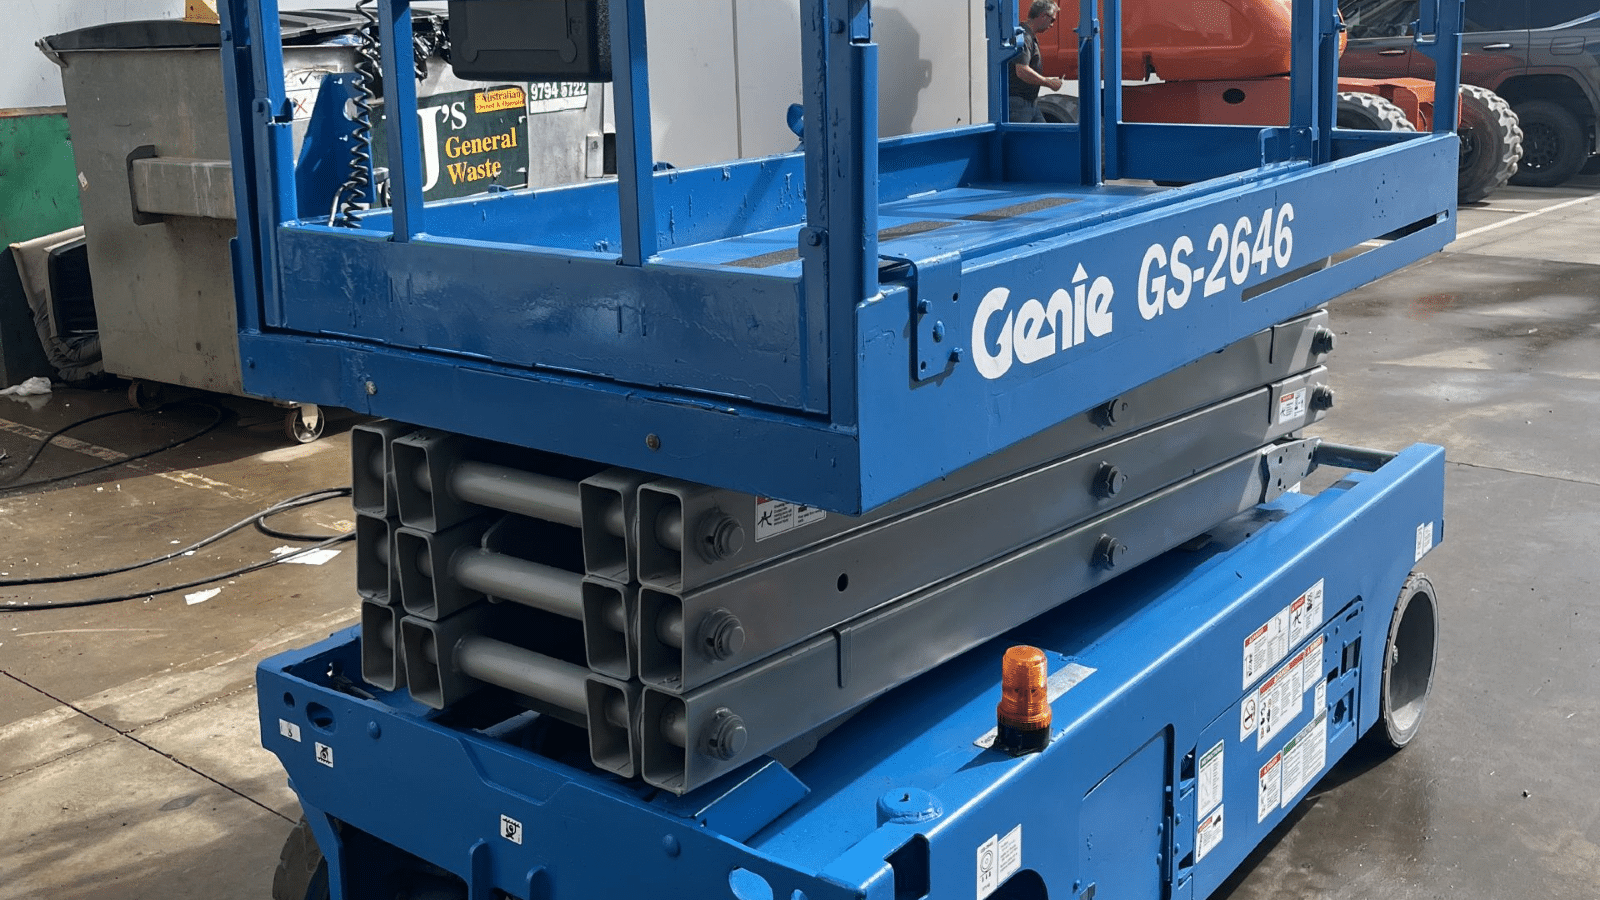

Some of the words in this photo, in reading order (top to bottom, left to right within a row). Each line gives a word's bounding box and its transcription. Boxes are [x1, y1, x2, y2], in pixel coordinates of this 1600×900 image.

[531, 82, 559, 100] 9794
[445, 127, 518, 158] General
[446, 159, 502, 185] Waste
[971, 262, 1114, 380] Genie
[1137, 202, 1295, 320] GS-2646
